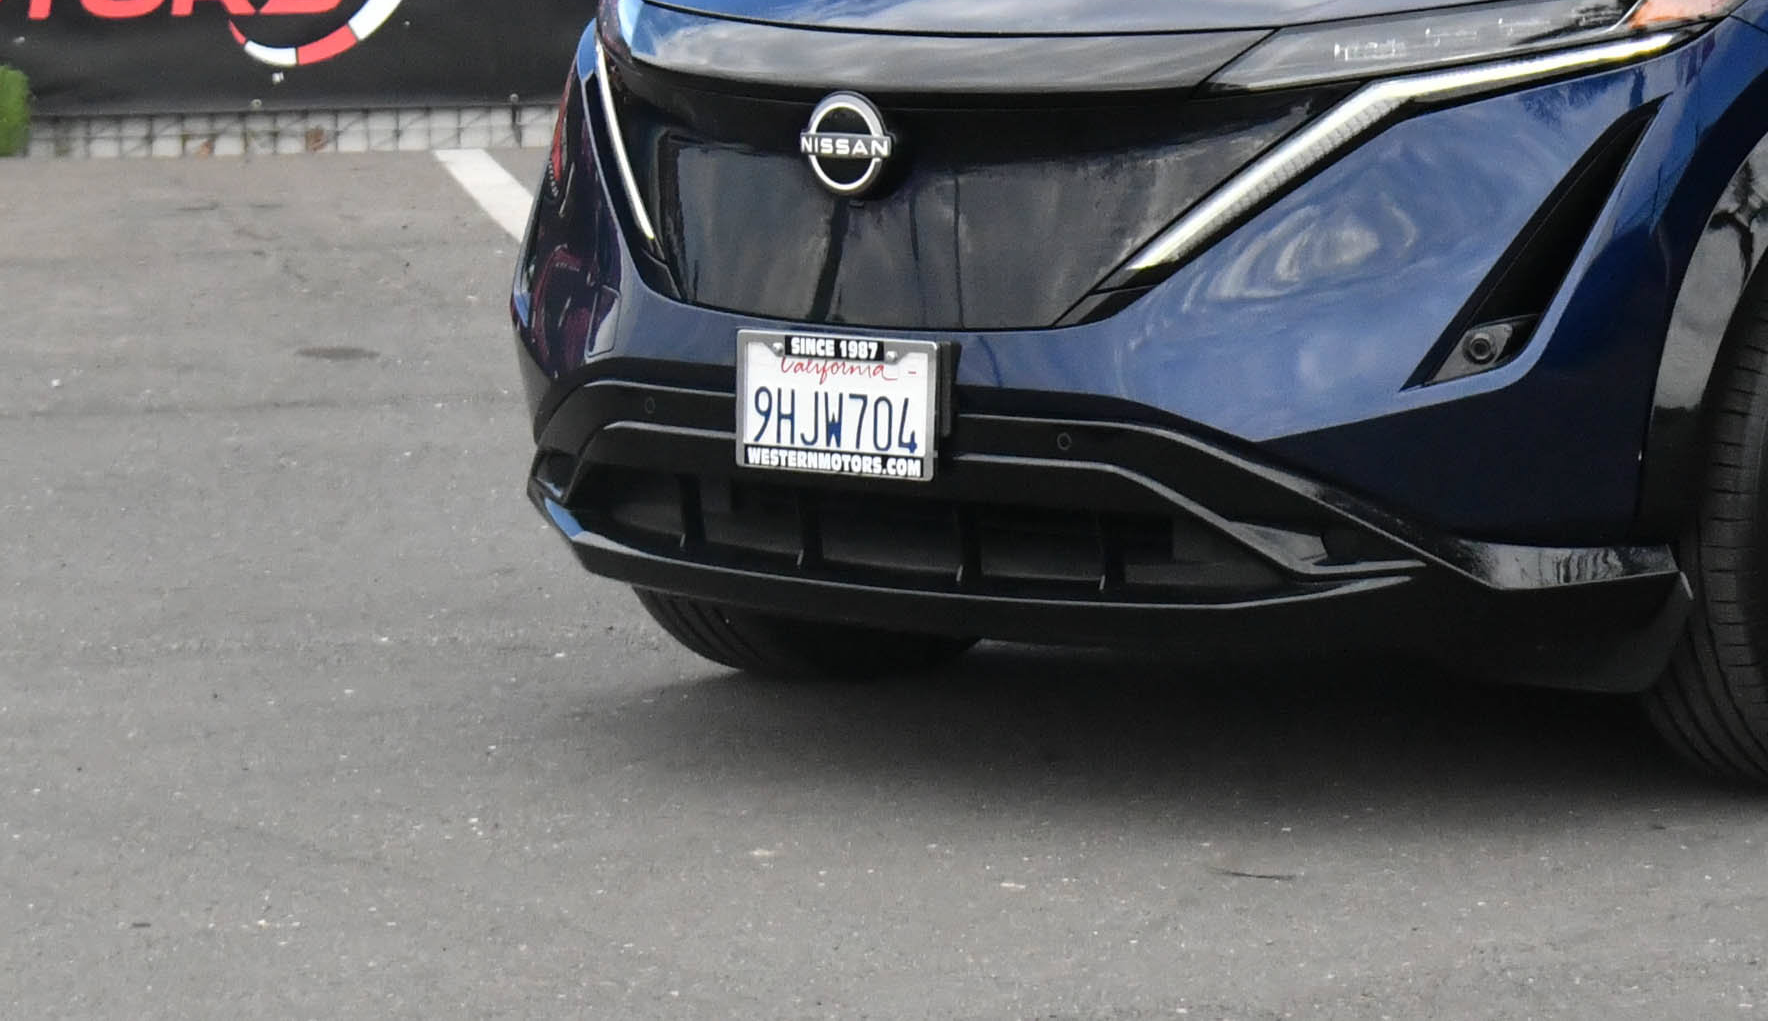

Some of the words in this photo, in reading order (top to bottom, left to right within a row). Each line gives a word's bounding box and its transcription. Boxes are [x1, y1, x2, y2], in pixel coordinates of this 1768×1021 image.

[801, 136, 889, 157] NISSAN
[790, 336, 835, 357] SINCE
[839, 339, 879, 360] 1987
[780, 356, 899, 386] California
[753, 385, 918, 455] 9HJW704
[747, 446, 922, 478] WESTERNMOTORS.COM
